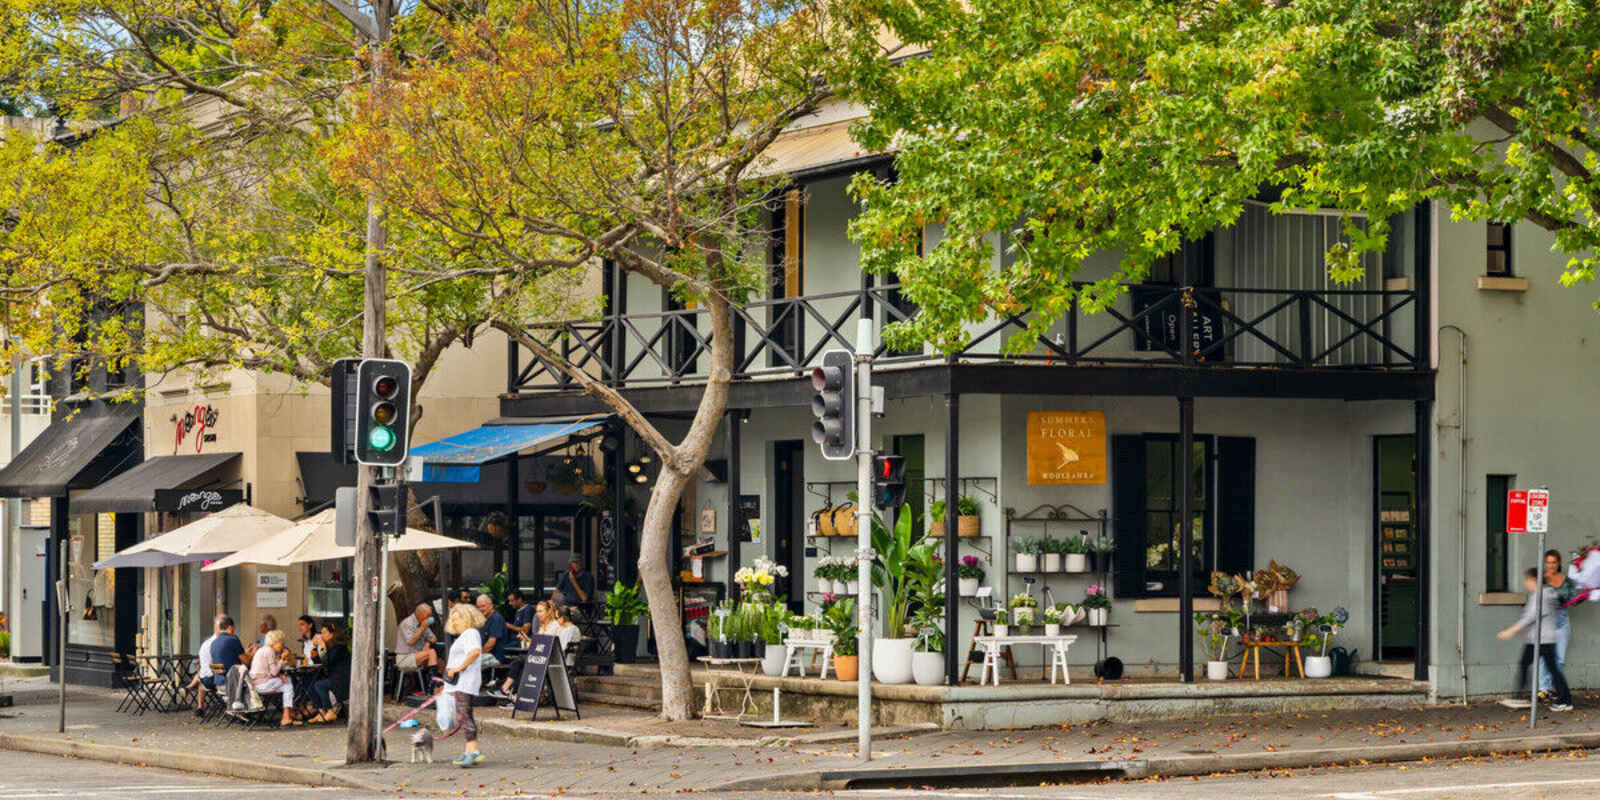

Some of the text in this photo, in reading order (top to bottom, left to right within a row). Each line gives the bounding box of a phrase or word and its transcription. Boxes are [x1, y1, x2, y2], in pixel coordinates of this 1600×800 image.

[1168, 314, 1177, 341] Open
[1202, 315, 1213, 341] ART
[1041, 415, 1097, 424] SUMMERS
[1041, 427, 1092, 440] FLORAL
[1042, 472, 1095, 480] WOOLLAHRA
[535, 643, 546, 653] ART
[527, 654, 548, 665] GALLERY
